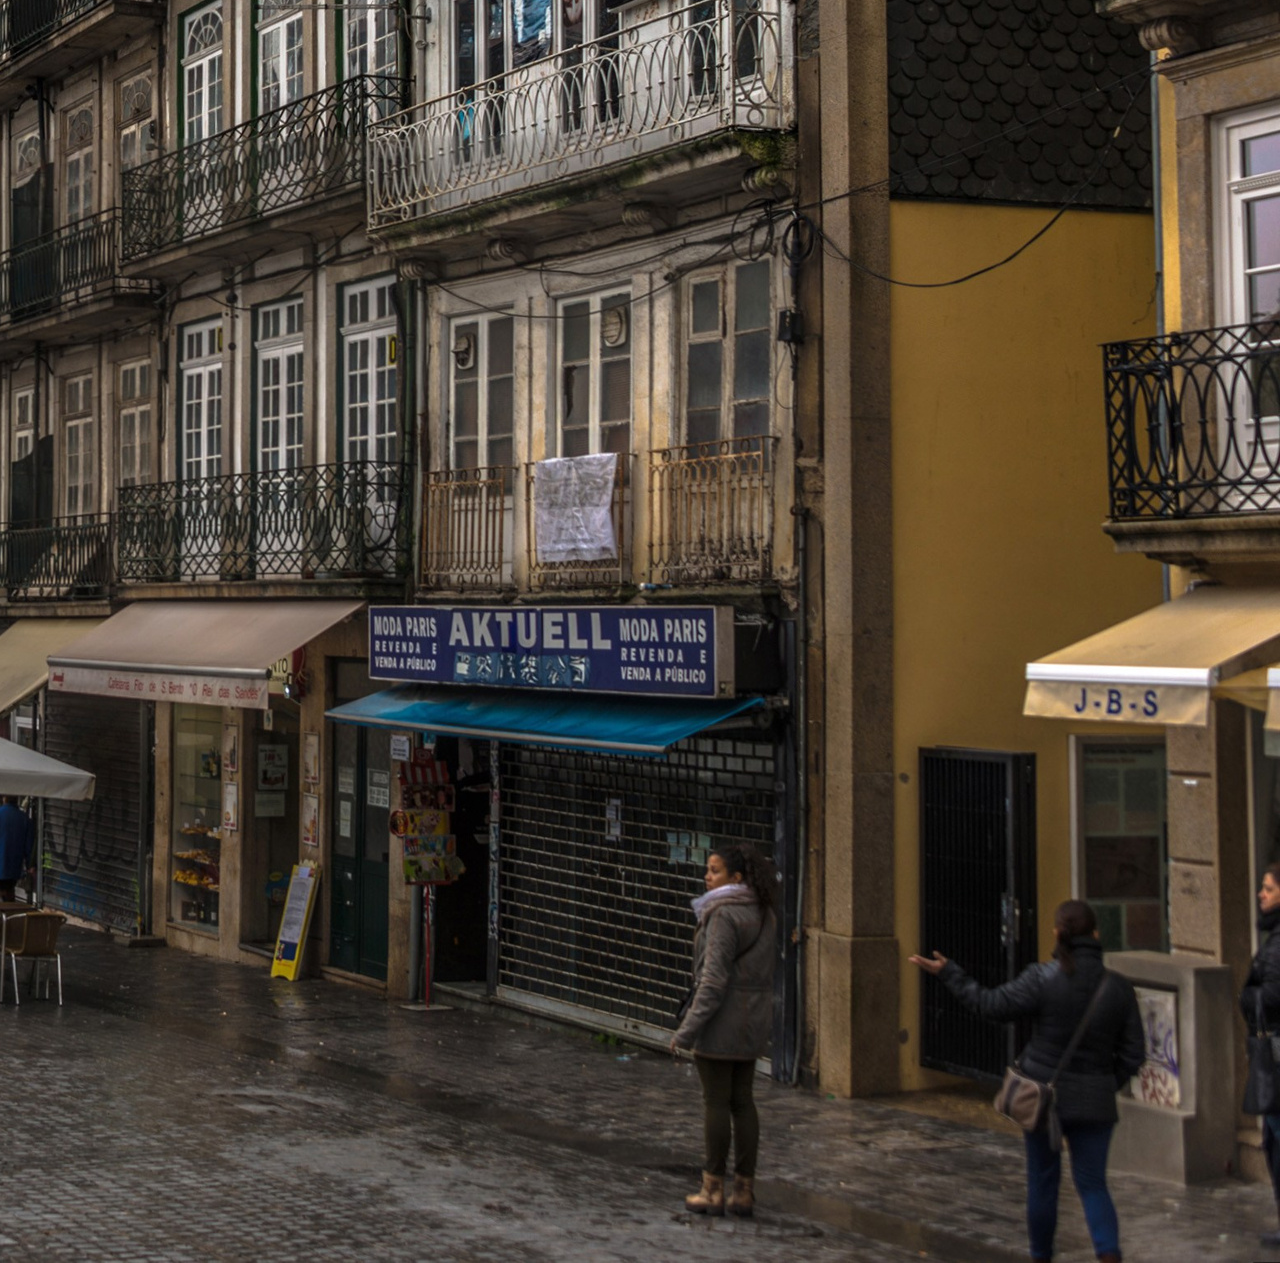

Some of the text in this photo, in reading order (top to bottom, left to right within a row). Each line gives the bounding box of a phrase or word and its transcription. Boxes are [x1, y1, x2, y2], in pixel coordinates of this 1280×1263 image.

[373, 615, 437, 638] MODA PARIS
[448, 612, 612, 650] AKTUELL
[619, 618, 707, 643] MODA PARIS
[375, 640, 437, 655] REVENDA E
[621, 647, 707, 664] REVENDA E
[375, 656, 437, 671] VENDA A PÚBLICO
[621, 666, 706, 684] VENDA A PÚBLICO
[149, 681, 156, 692] de
[169, 682, 184, 695] Bento
[219, 686, 230, 699] das
